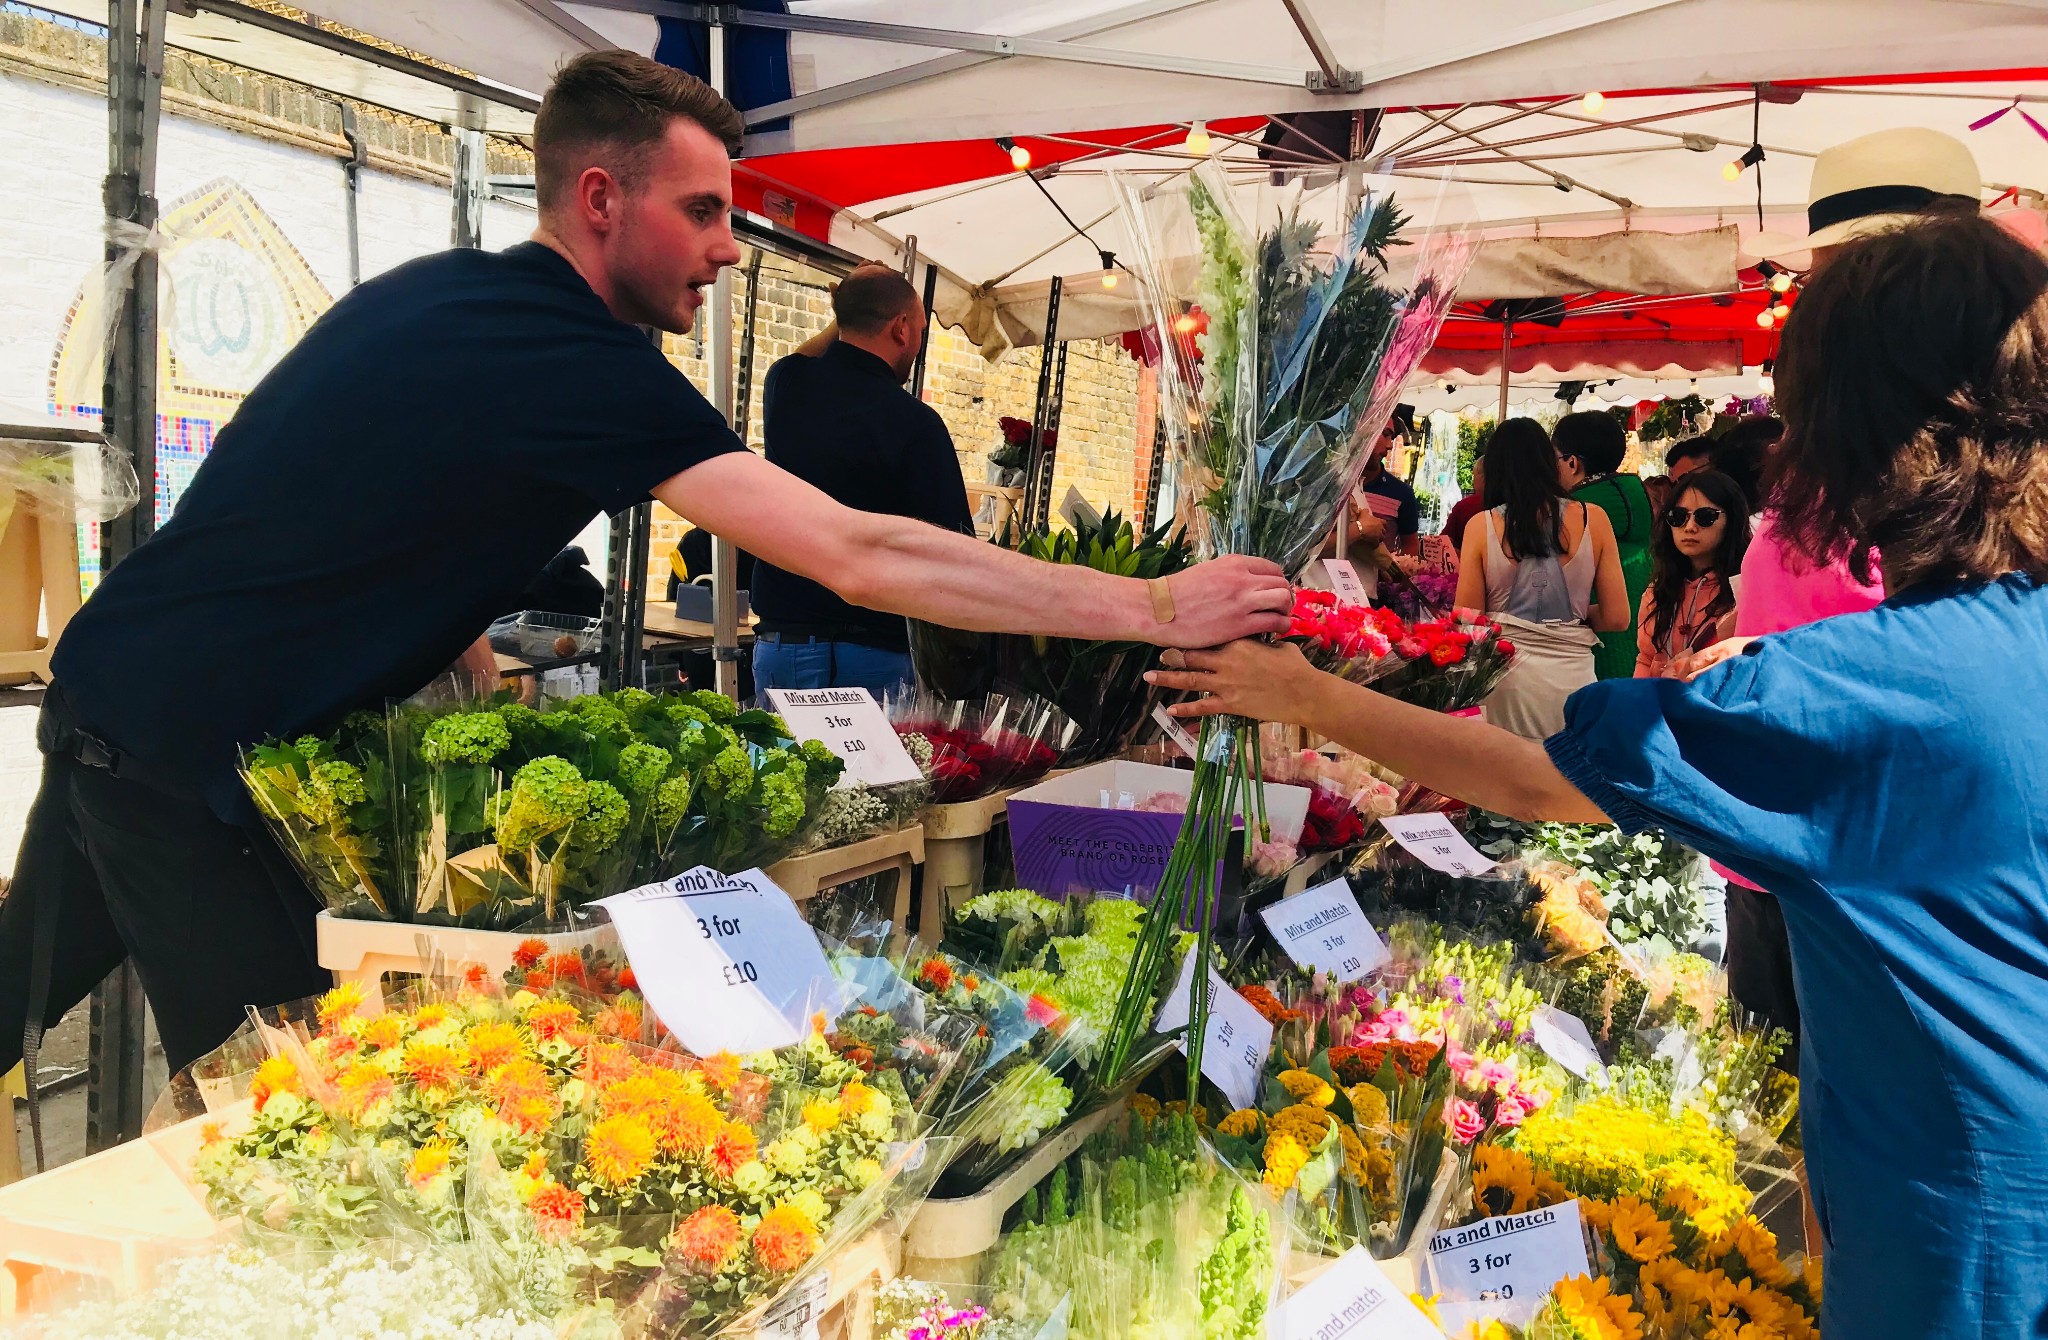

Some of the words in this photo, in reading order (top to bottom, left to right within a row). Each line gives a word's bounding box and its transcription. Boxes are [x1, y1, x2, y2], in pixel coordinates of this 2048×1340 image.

[784, 691, 806, 704] Mix
[808, 691, 829, 703] and
[830, 690, 864, 702] Match
[825, 716, 835, 728] 3
[835, 715, 853, 727] for
[844, 739, 866, 753] £10
[1048, 836, 1080, 847] MEET
[1086, 839, 1109, 850] THE
[1401, 830, 1419, 841] Mix
[1418, 829, 1431, 839] and
[1061, 848, 1103, 861] BRAND
[1109, 853, 1125, 862] OF
[1432, 846, 1441, 855] 3
[1440, 845, 1452, 855] for
[674, 869, 708, 892] and
[697, 917, 712, 939] 3
[712, 914, 741, 937] for
[1284, 923, 1305, 939] Mix
[1305, 912, 1322, 930] and
[1320, 902, 1350, 922] Match
[1322, 939, 1333, 951] 3
[1330, 935, 1346, 947] for
[1342, 956, 1361, 973] £10
[723, 960, 758, 987] £10
[1219, 1020, 1234, 1040] for
[1217, 1034, 1230, 1048] 3
[1243, 1045, 1258, 1070] £10
[1457, 1222, 1491, 1245] and
[1495, 1210, 1555, 1235] Match
[1469, 1258, 1480, 1274] 3
[1485, 1253, 1512, 1270] for
[1342, 1286, 1383, 1322] match
